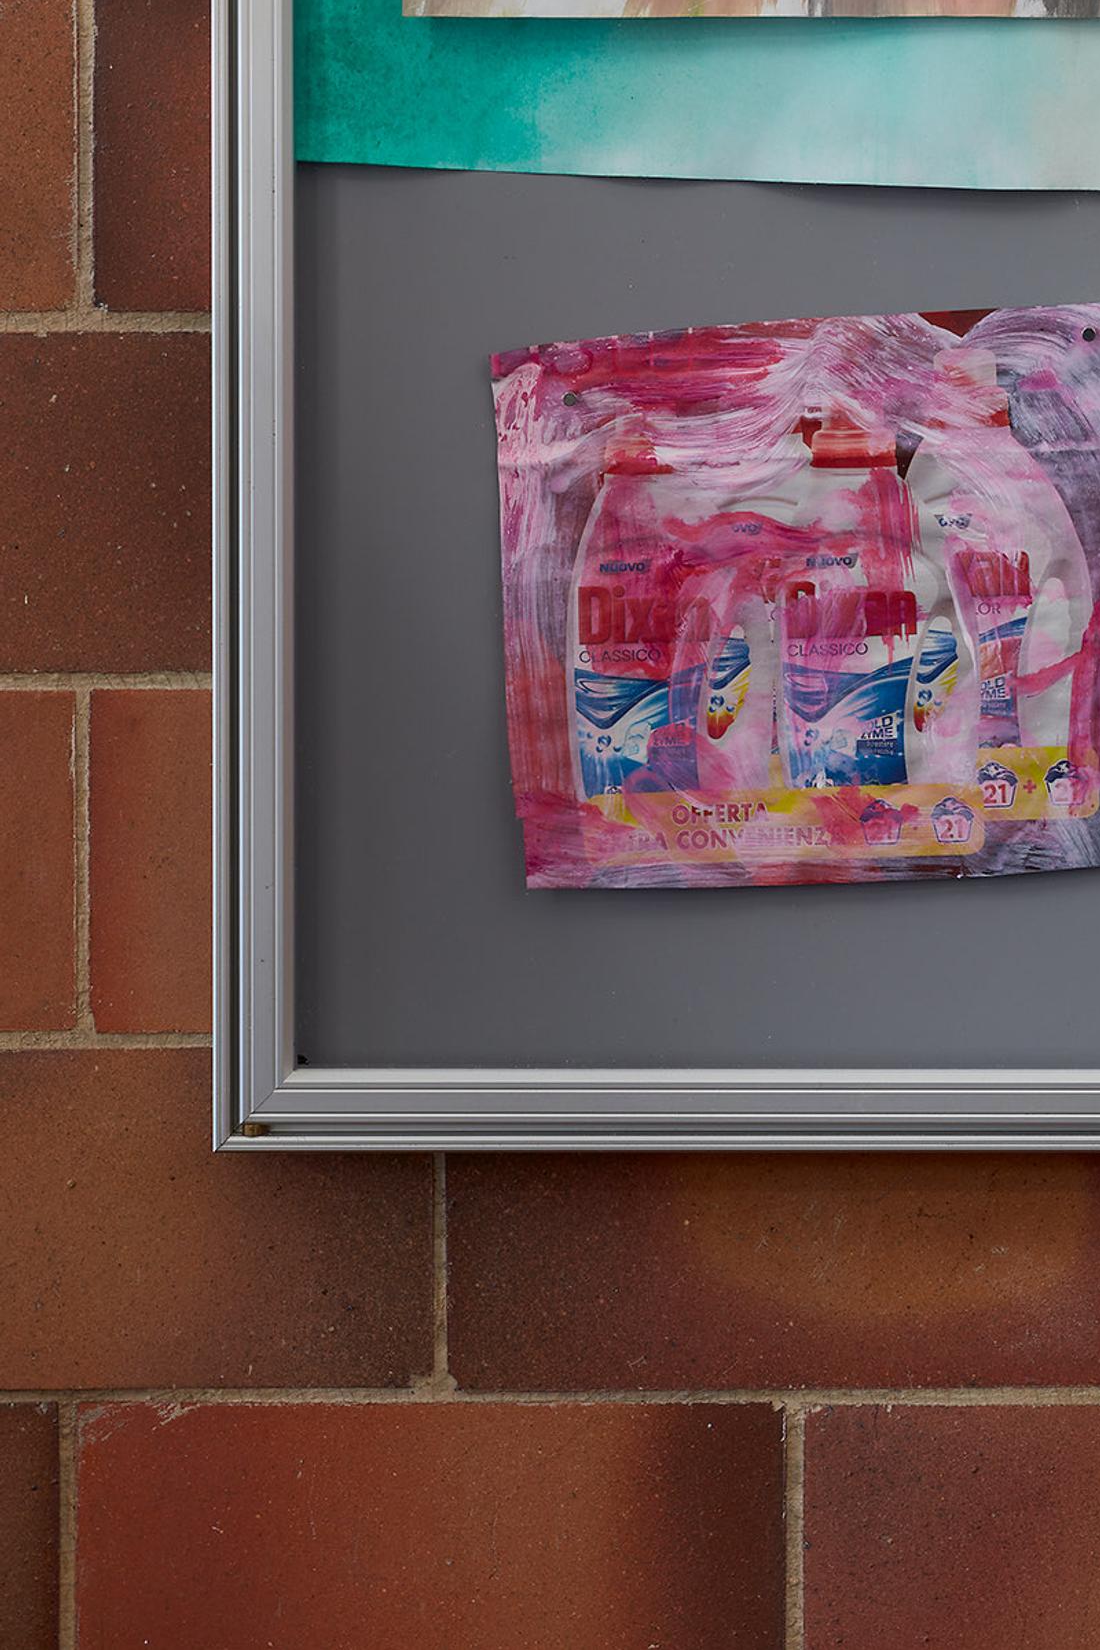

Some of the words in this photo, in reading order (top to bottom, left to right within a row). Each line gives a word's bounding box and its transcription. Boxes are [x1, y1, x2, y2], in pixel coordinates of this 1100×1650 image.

[579, 648, 662, 664] CLASSICO
[786, 641, 869, 658] CLASSICO
[984, 784, 1008, 804] 21
[672, 802, 770, 826] OFFERTA
